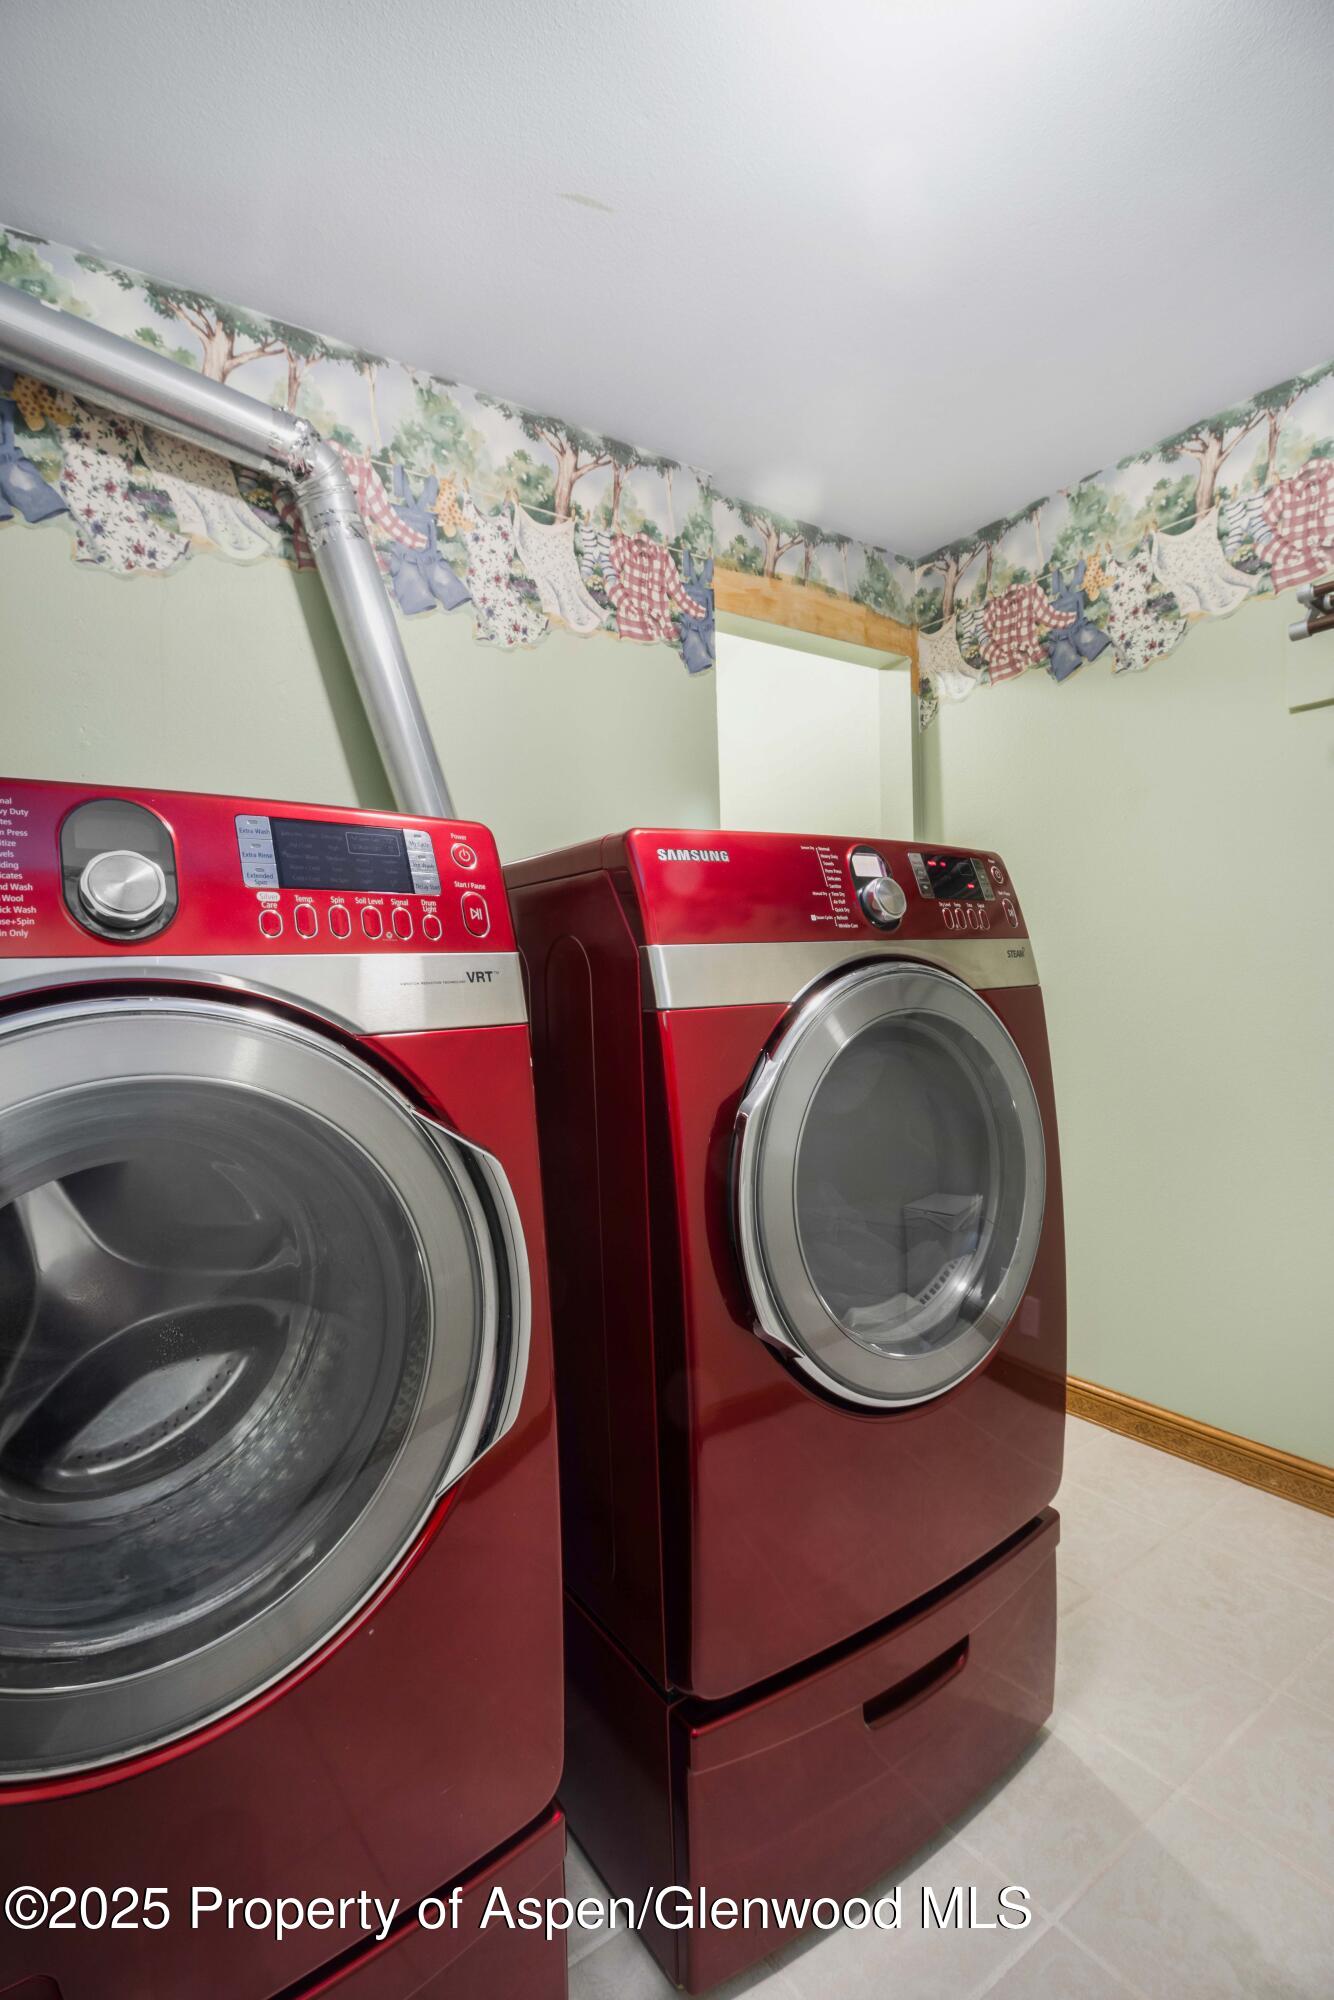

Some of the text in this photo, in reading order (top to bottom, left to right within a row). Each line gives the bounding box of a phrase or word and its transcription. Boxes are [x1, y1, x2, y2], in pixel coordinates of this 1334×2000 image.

[9, 808, 29, 818] Duty
[6, 829, 28, 837] Press
[656, 848, 730, 862] SAMSUNG
[9, 883, 33, 891] Wash
[471, 882, 486, 890] Pause
[1, 894, 24, 902] Wool
[330, 896, 345, 904] Spin
[355, 897, 367, 905] Soil
[391, 899, 409, 907] Signal
[421, 899, 437, 907] Drum
[13, 906, 37, 914] Wash
[9, 929, 29, 939] Only
